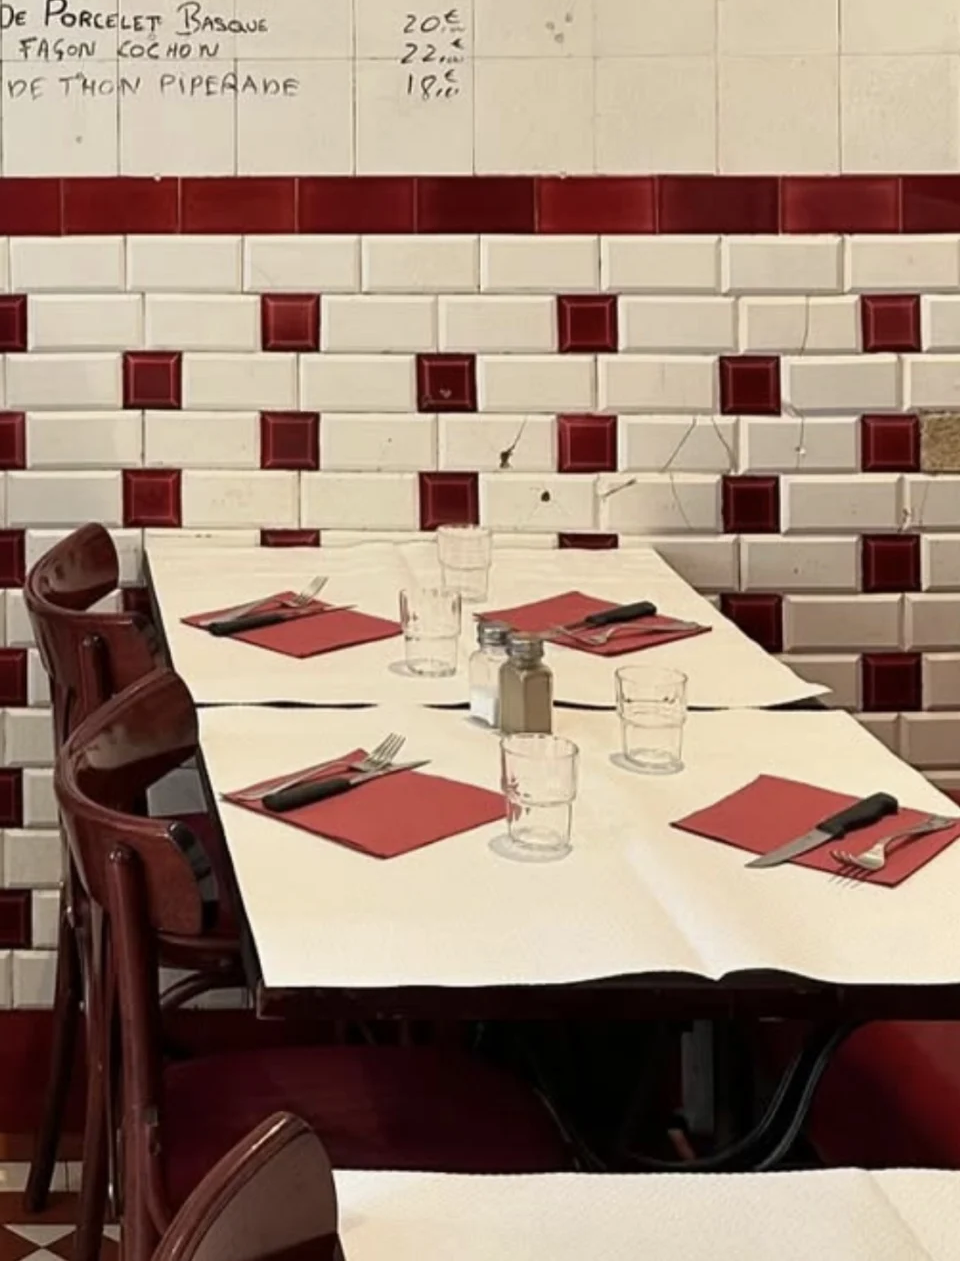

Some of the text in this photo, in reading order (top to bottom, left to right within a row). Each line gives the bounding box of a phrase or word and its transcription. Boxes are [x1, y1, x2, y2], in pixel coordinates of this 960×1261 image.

[0, 3, 27, 29] DE
[175, 0, 269, 36] BASQUE
[117, 40, 220, 59] COCHON
[7, 79, 45, 99] DE
[159, 72, 301, 97] PIPERADE
